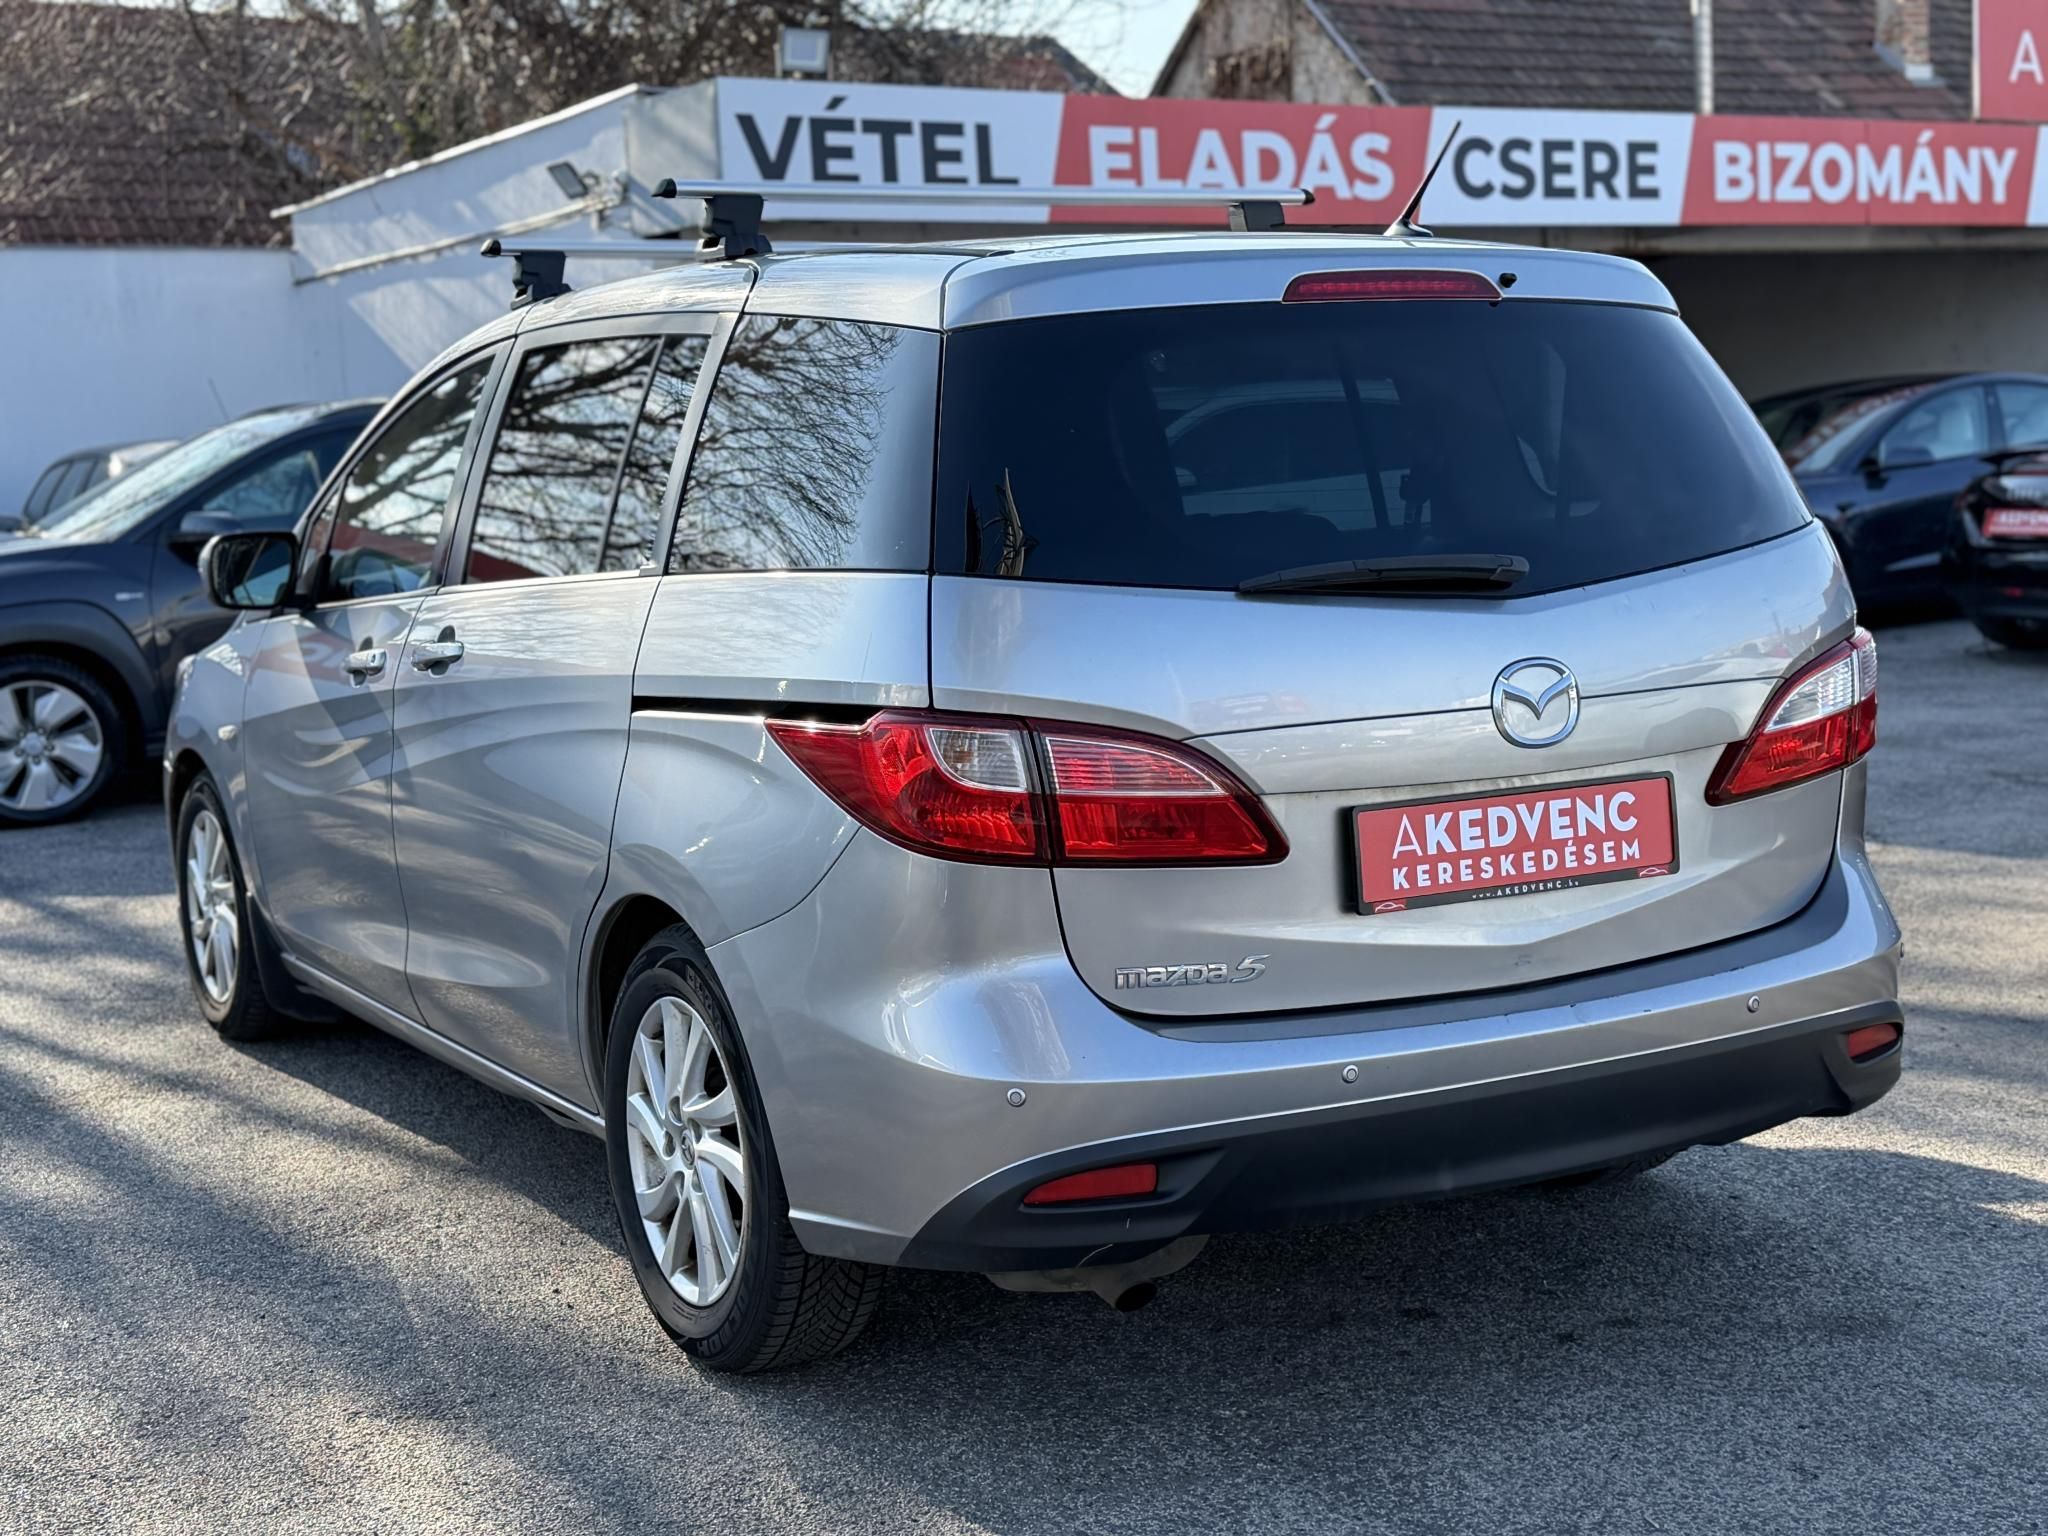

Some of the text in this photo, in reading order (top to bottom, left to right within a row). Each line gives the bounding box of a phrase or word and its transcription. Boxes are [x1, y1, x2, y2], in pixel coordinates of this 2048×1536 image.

[734, 96, 2018, 204] VÉTEL ELADÁS CSERE BIZOMÁNY
[1392, 791, 1638, 860] AKEDVENC
[1392, 837, 1641, 890] KERESKEDÉSEM
